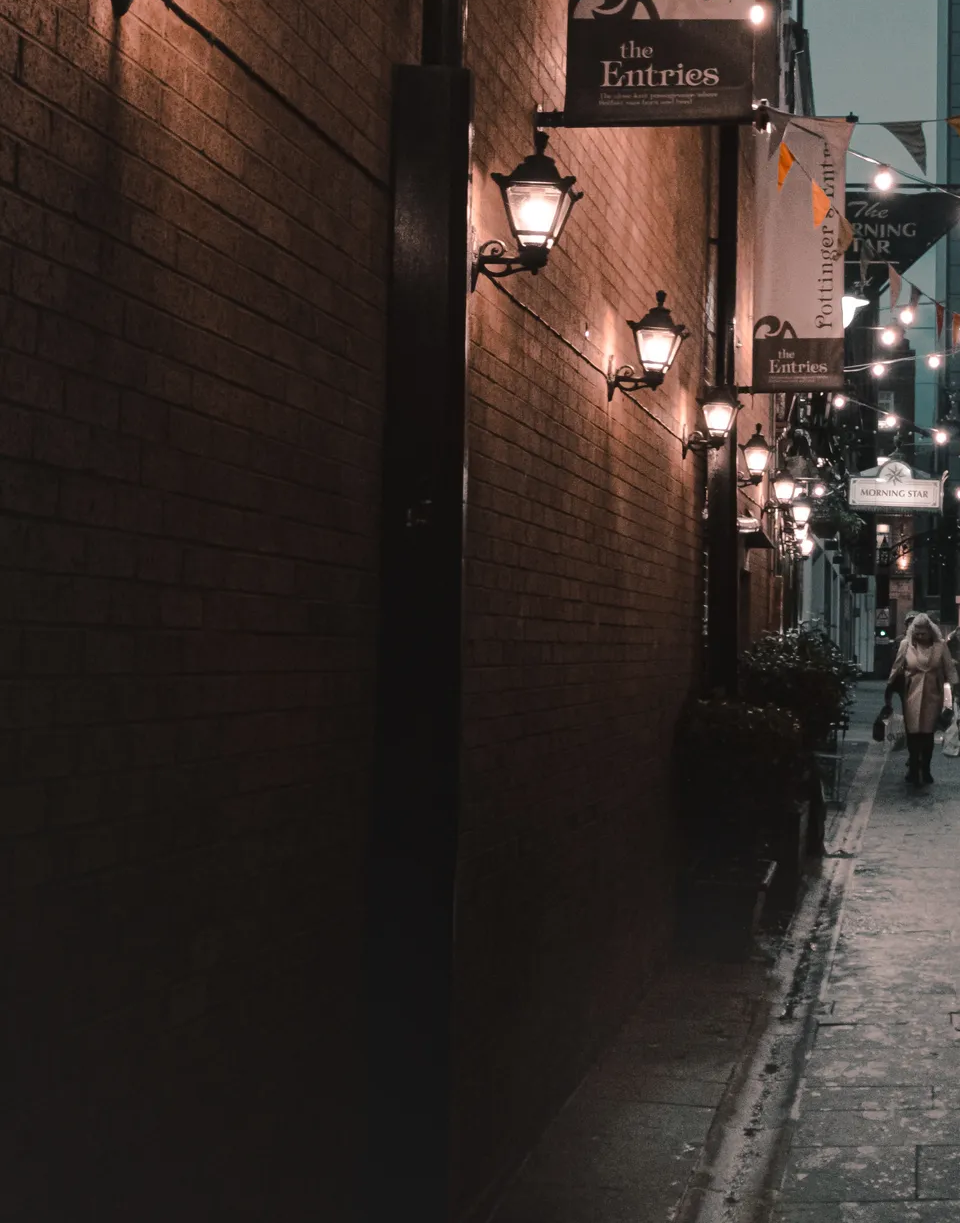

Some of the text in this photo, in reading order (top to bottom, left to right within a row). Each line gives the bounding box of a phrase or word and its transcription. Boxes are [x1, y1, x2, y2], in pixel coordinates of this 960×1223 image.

[620, 40, 654, 58] the
[600, 60, 720, 87] Entries
[847, 201, 889, 218] The
[853, 222, 917, 238] RNING
[853, 238, 891, 254] TAR
[815, 205, 840, 329] Pottingers
[778, 349, 795, 359] the
[769, 360, 828, 373] Entries
[860, 488, 929, 498] MORNING STAR
